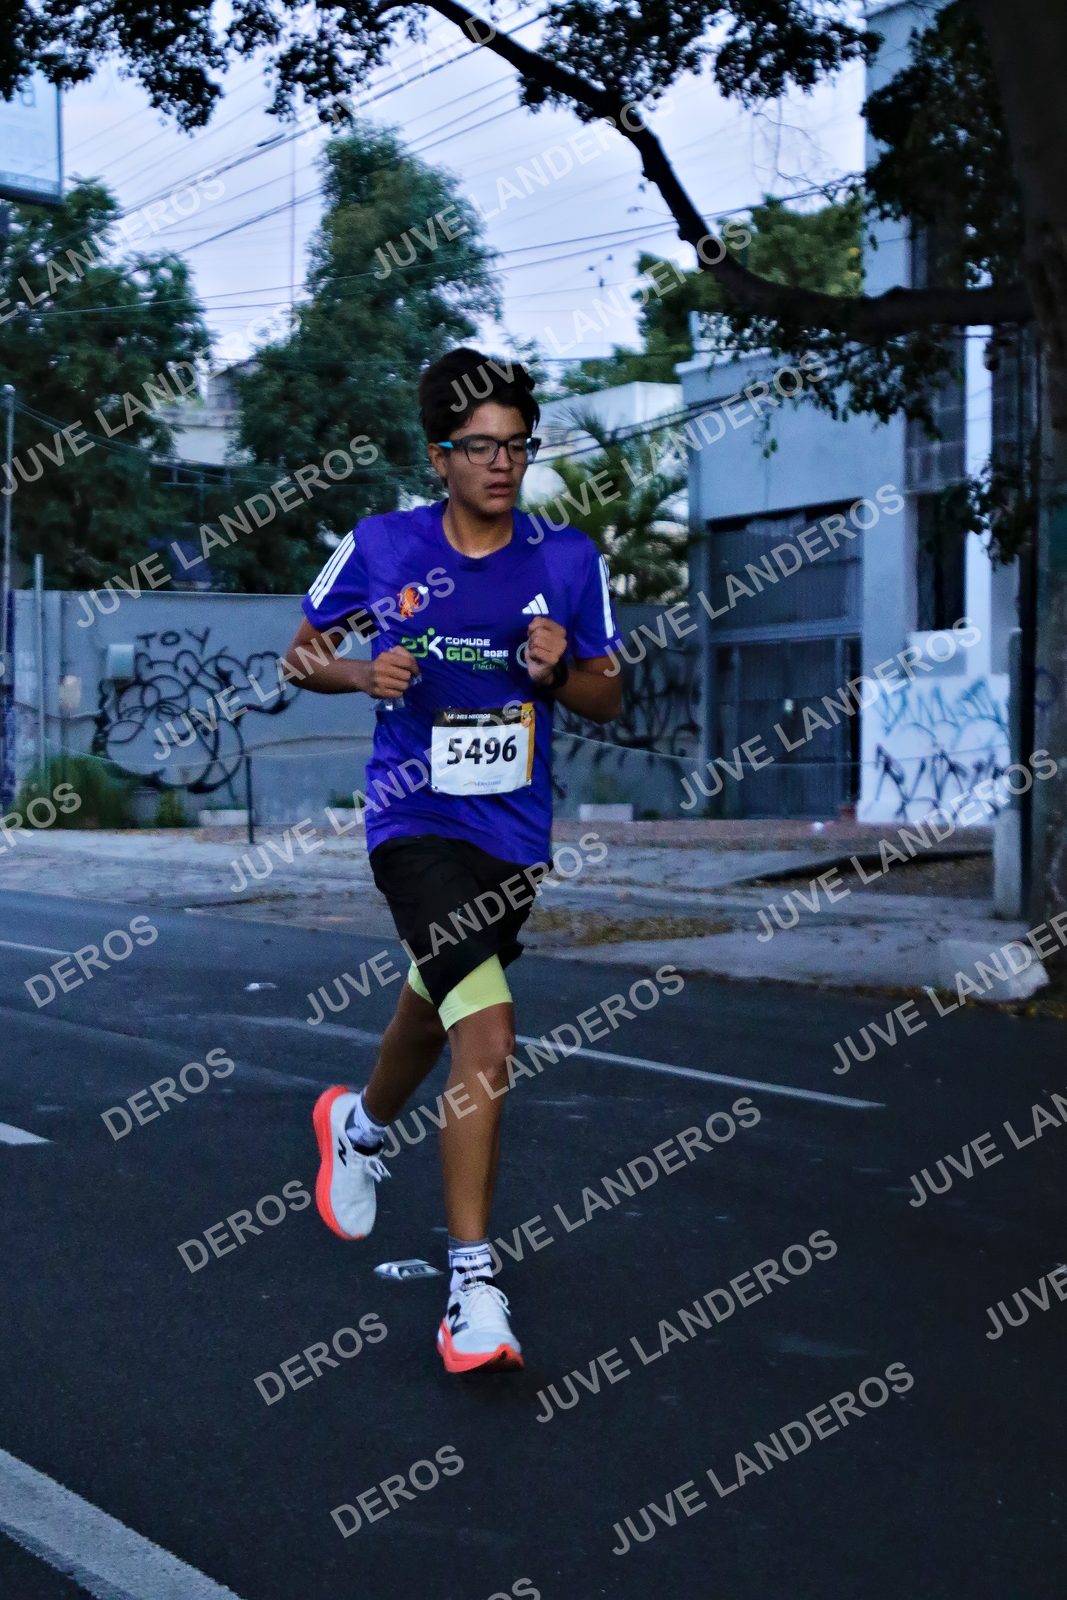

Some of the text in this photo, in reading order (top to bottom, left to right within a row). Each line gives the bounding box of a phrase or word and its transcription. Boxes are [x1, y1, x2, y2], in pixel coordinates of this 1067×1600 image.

[445, 636, 490, 646] COMUDE
[445, 646, 485, 662] GDL
[447, 735, 517, 765] 5496
